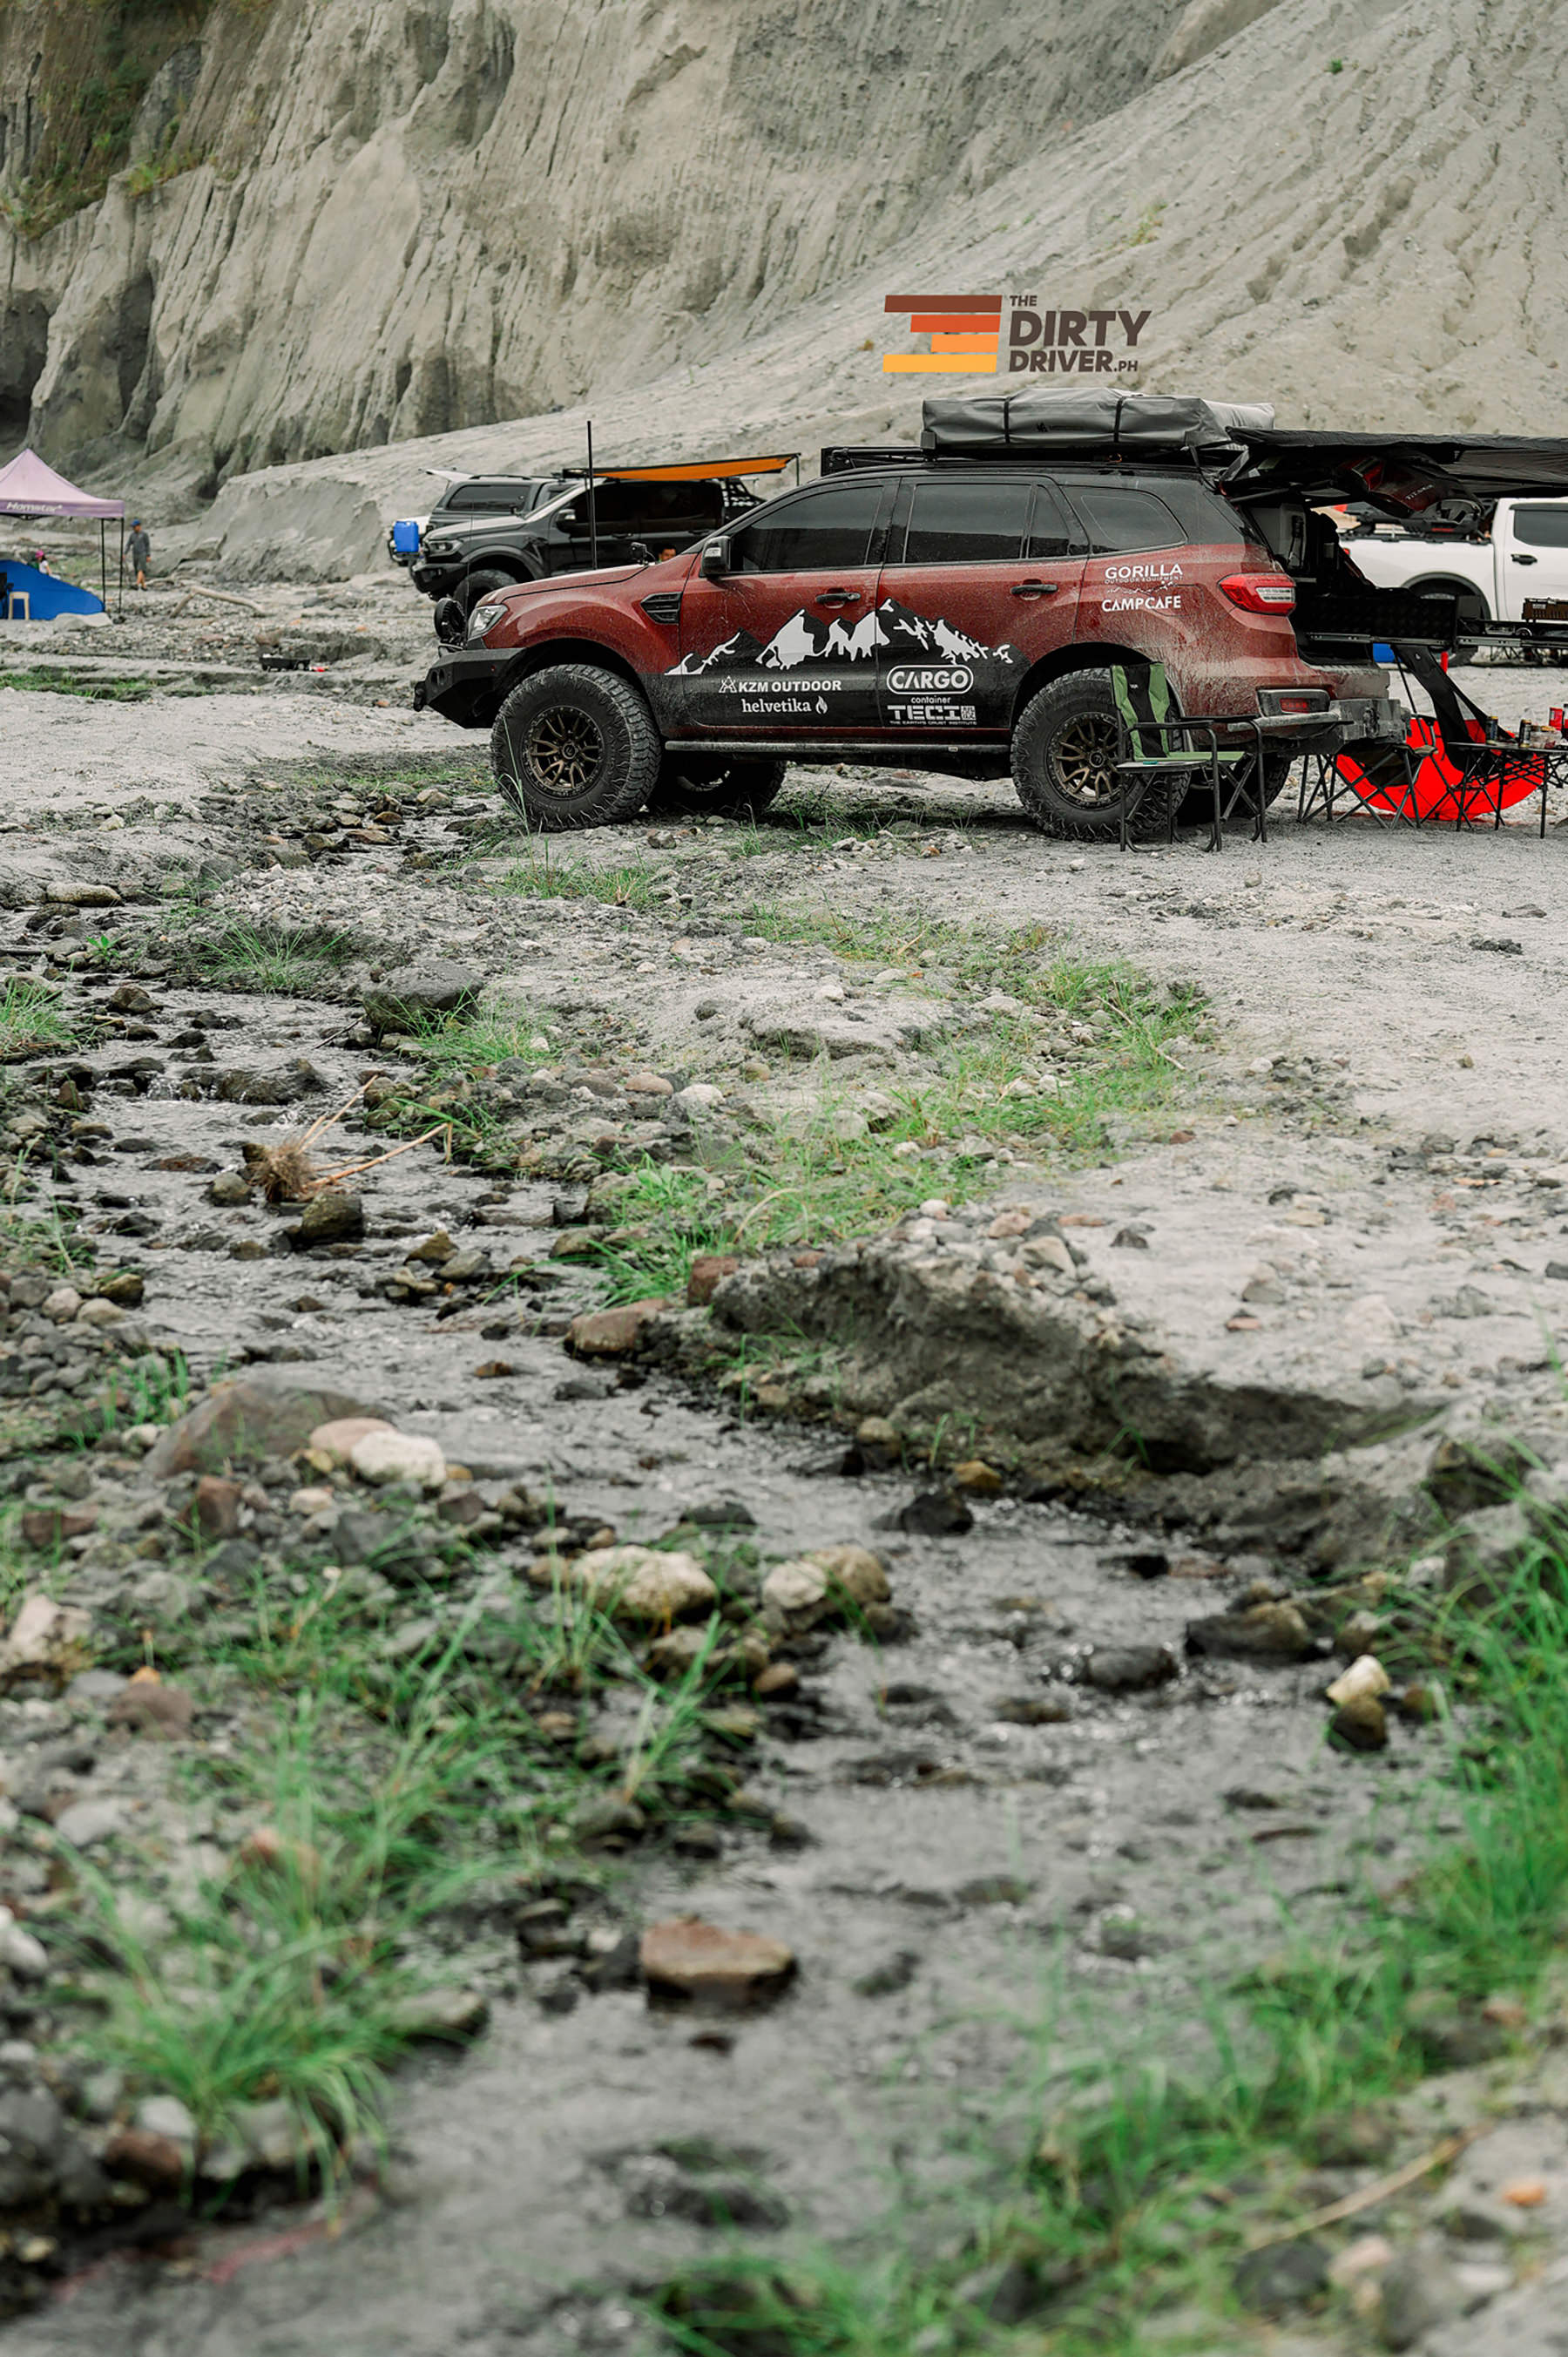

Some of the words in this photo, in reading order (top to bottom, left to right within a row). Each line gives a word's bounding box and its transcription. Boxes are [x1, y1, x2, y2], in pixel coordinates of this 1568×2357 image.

[1105, 563, 1183, 579] GORILLA
[891, 669, 970, 689] CARGO
[739, 681, 768, 693] KZM
[771, 680, 842, 693] OUTDOOR
[741, 698, 812, 712] helvetika
[910, 695, 951, 704] container
